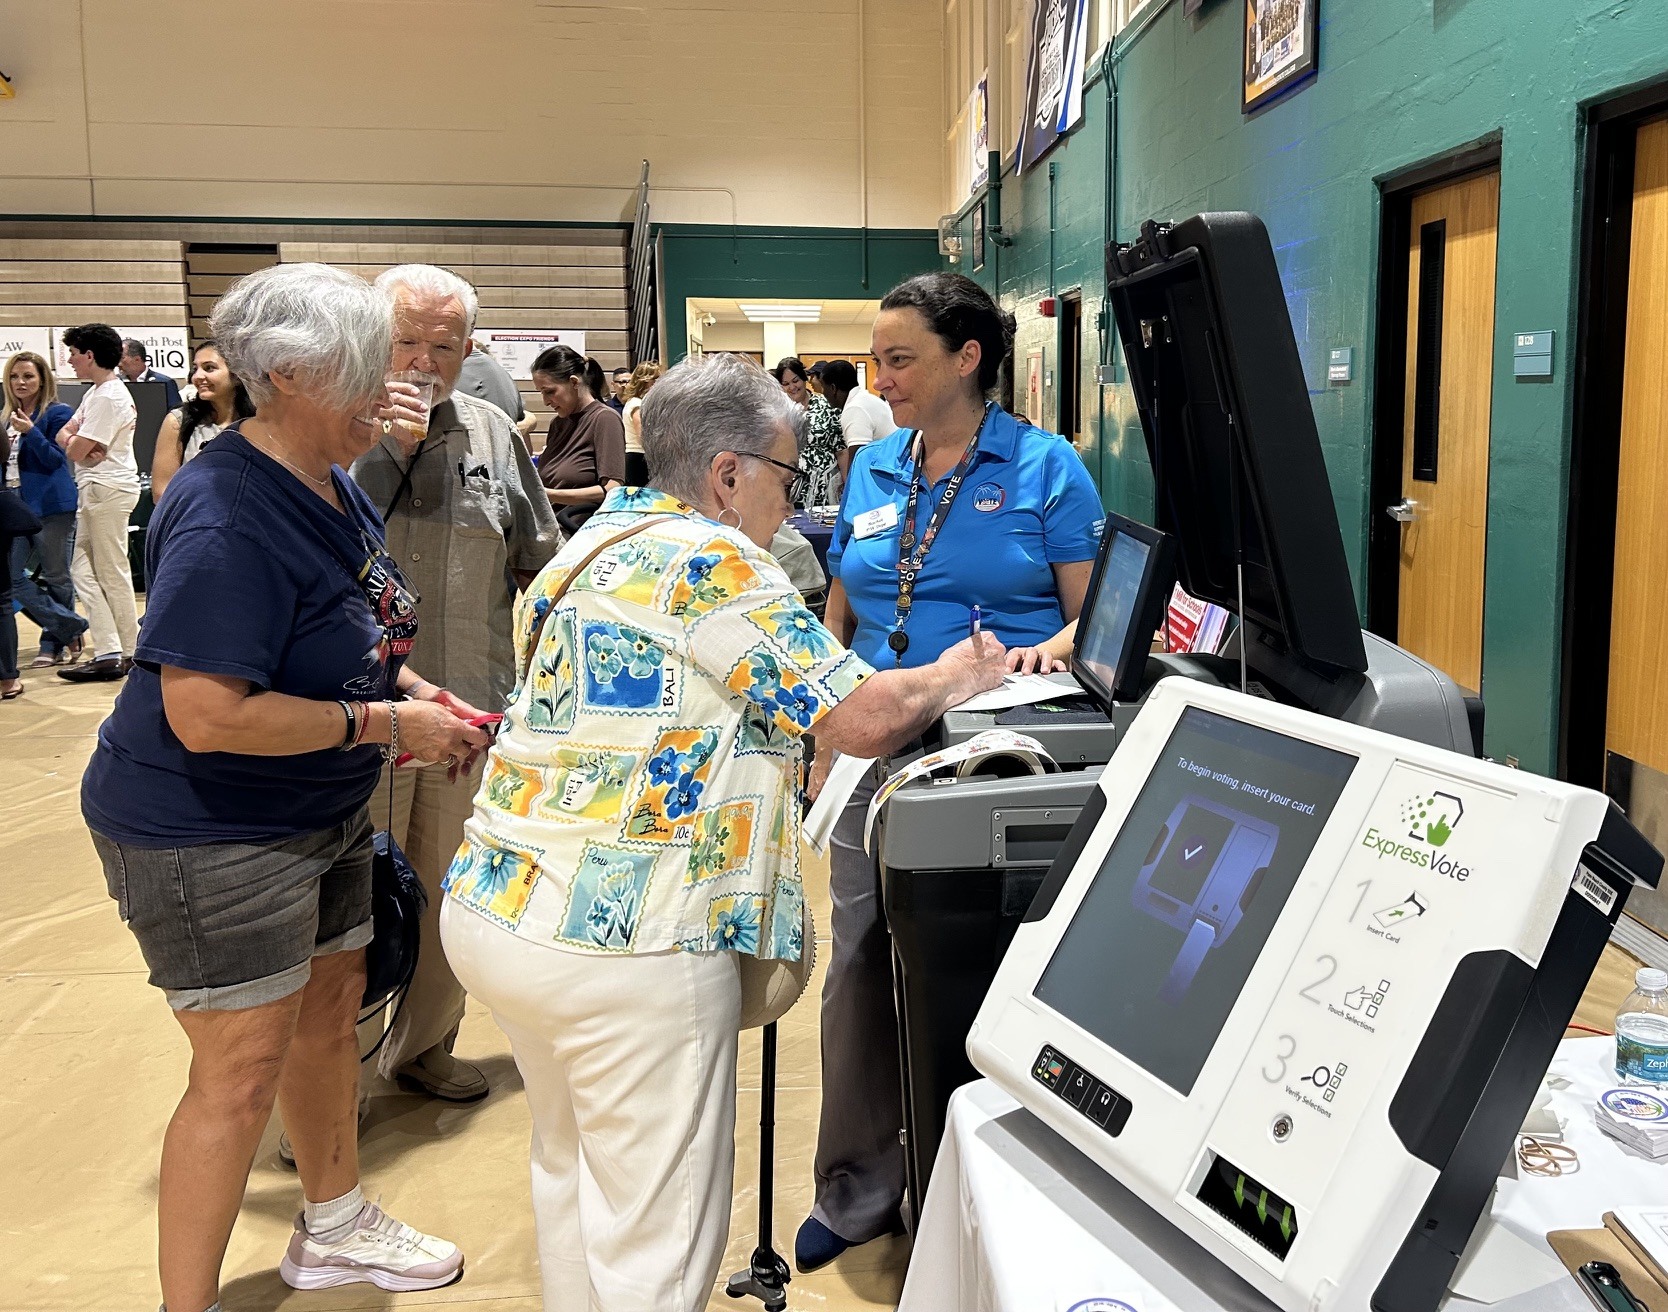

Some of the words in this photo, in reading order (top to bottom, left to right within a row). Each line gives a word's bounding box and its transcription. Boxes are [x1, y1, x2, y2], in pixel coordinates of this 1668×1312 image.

[162, 337, 184, 346] Post
[908, 476, 919, 507] VOTE
[940, 475, 961, 505] VOTE
[596, 561, 617, 586] FIJI
[663, 668, 676, 707] BALI
[1177, 757, 1187, 768] To
[1187, 761, 1211, 777] begin
[1211, 772, 1239, 790] voting,
[1241, 780, 1269, 799] insert
[1267, 791, 1292, 806] your
[1291, 800, 1316, 816] card.
[633, 803, 662, 819] Bora
[638, 818, 669, 835] Bora
[584, 847, 608, 866] Peru
[1362, 827, 1470, 882] ExpressVote
[1349, 879, 1372, 923] 1
[1366, 924, 1385, 937] Insert
[1385, 932, 1401, 944] Card
[1299, 954, 1338, 1005] 2
[1327, 1004, 1344, 1019] Touch
[1344, 1012, 1376, 1034] Selections
[1261, 1034, 1297, 1085] 3
[1285, 1085, 1303, 1102] Verify
[1301, 1095, 1332, 1119] Selections
